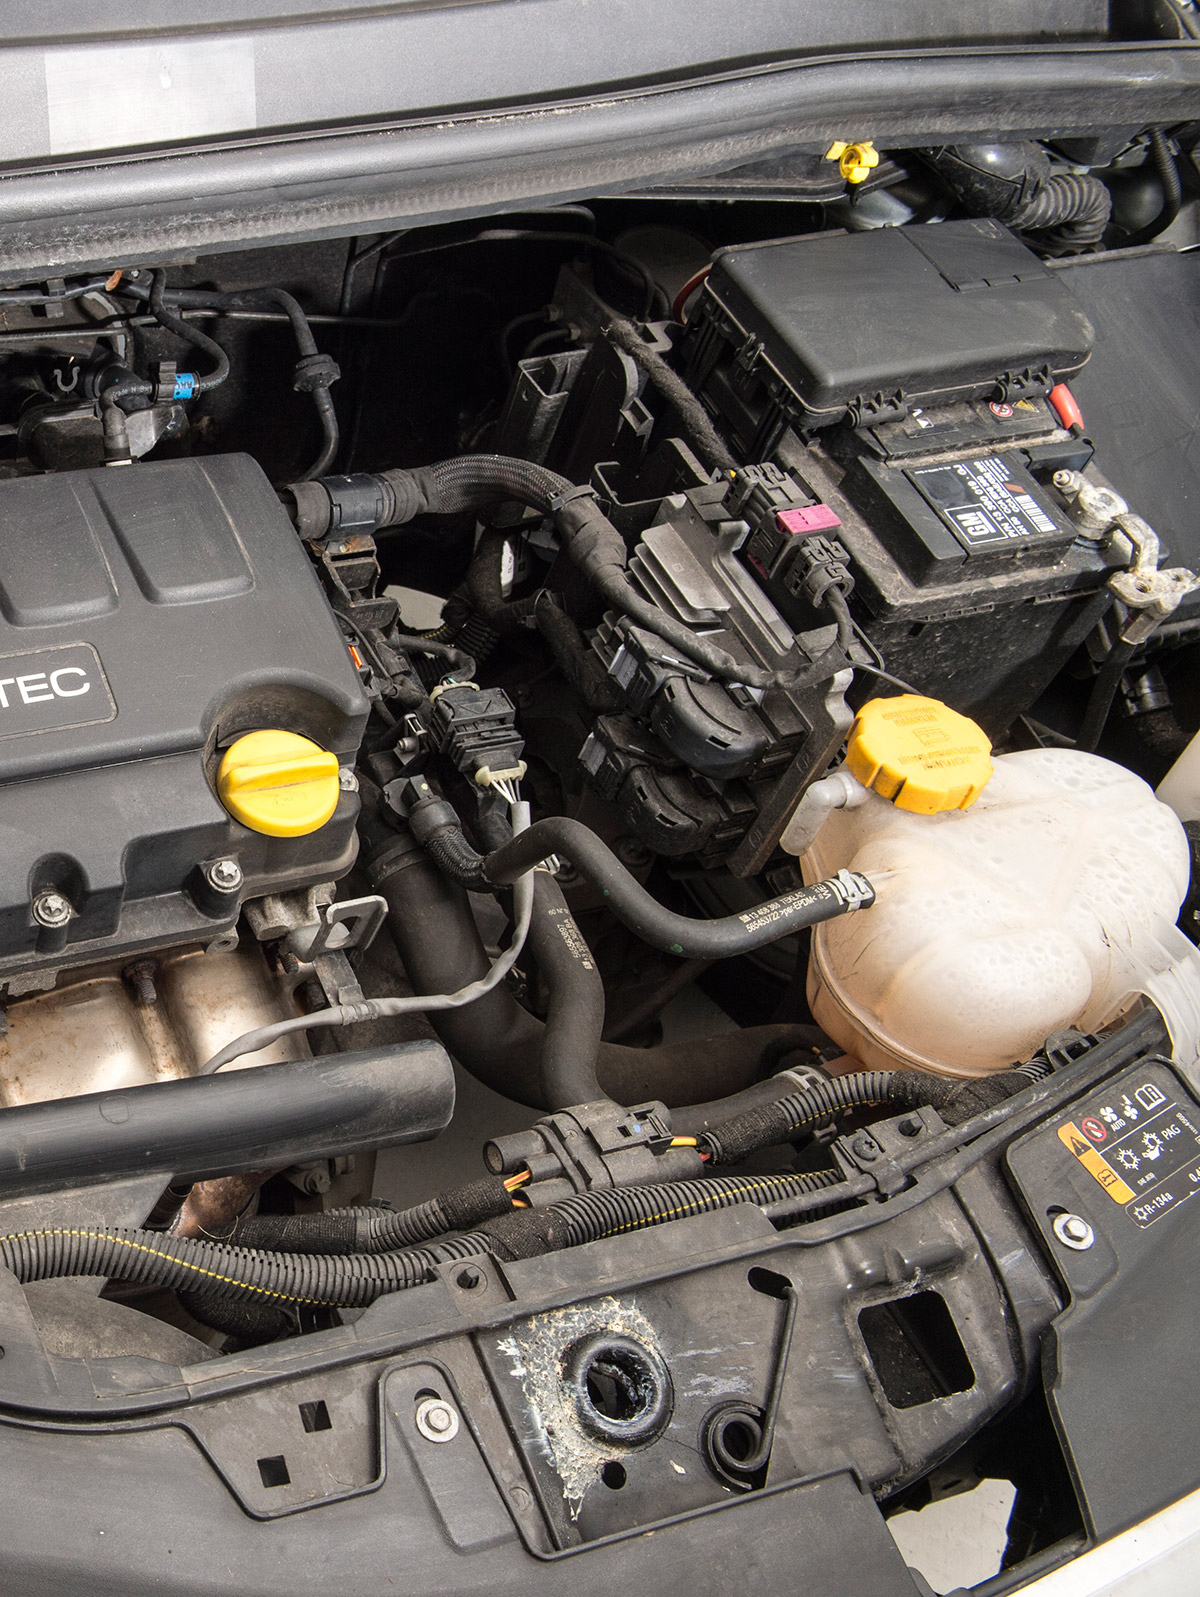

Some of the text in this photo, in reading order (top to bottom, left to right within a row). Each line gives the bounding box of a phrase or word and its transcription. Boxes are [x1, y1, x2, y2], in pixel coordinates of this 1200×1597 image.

[956, 512, 990, 536] GM
[1000, 522, 1019, 538] P/N
[1110, 1118, 1126, 1132] AUTO
[1161, 1124, 1181, 1140] PAG
[1144, 1192, 1174, 1214] R-134a
